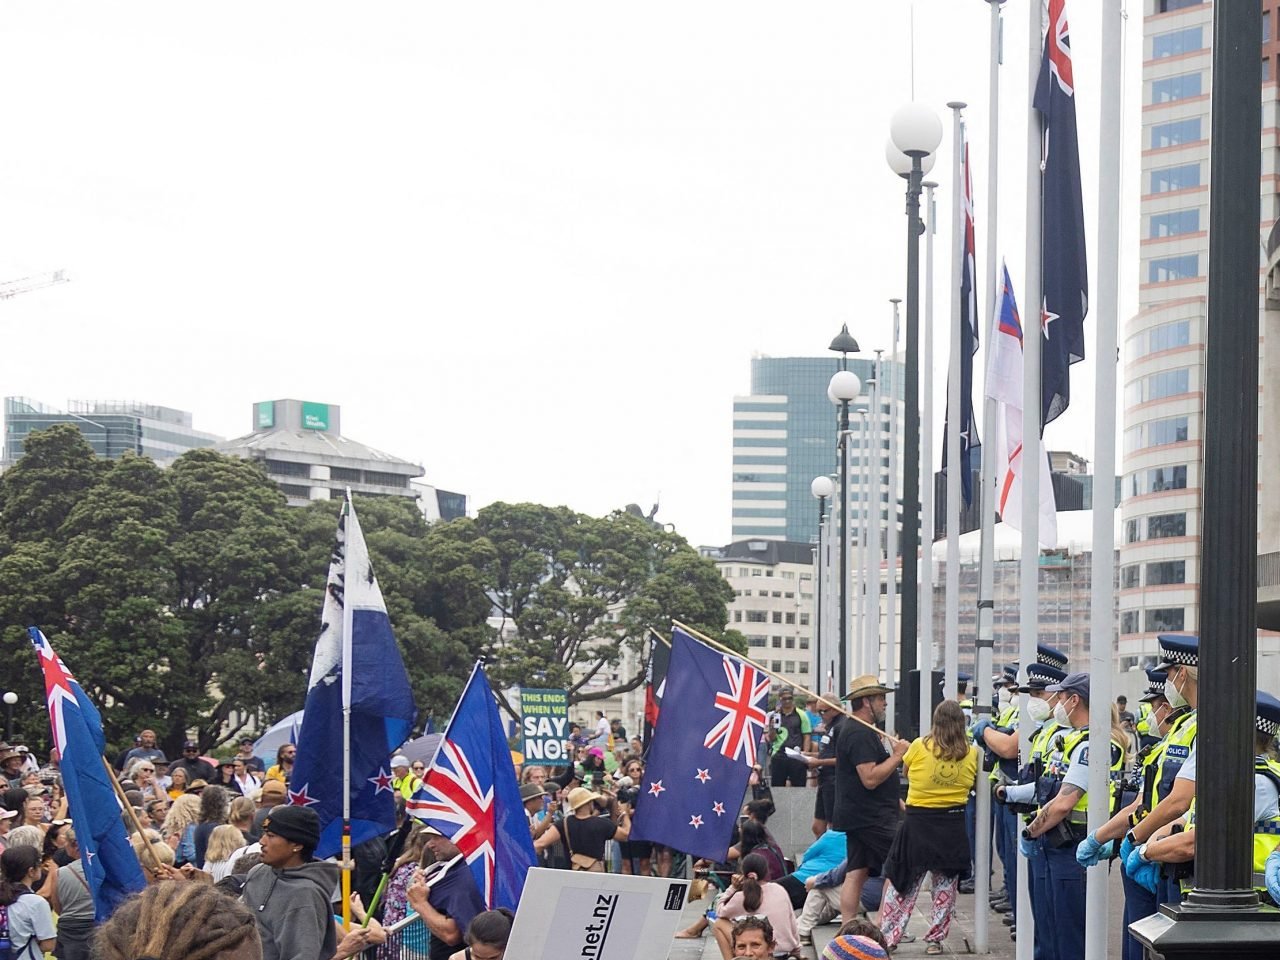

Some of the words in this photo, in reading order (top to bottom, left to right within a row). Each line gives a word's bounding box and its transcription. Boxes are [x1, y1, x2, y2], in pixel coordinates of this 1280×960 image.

[522, 694, 541, 702] THIS
[542, 695, 566, 703] ENDS
[522, 705, 550, 714] WHEN
[552, 706, 567, 714] WE
[524, 716, 567, 737] SAY
[525, 738, 569, 760] NO!
